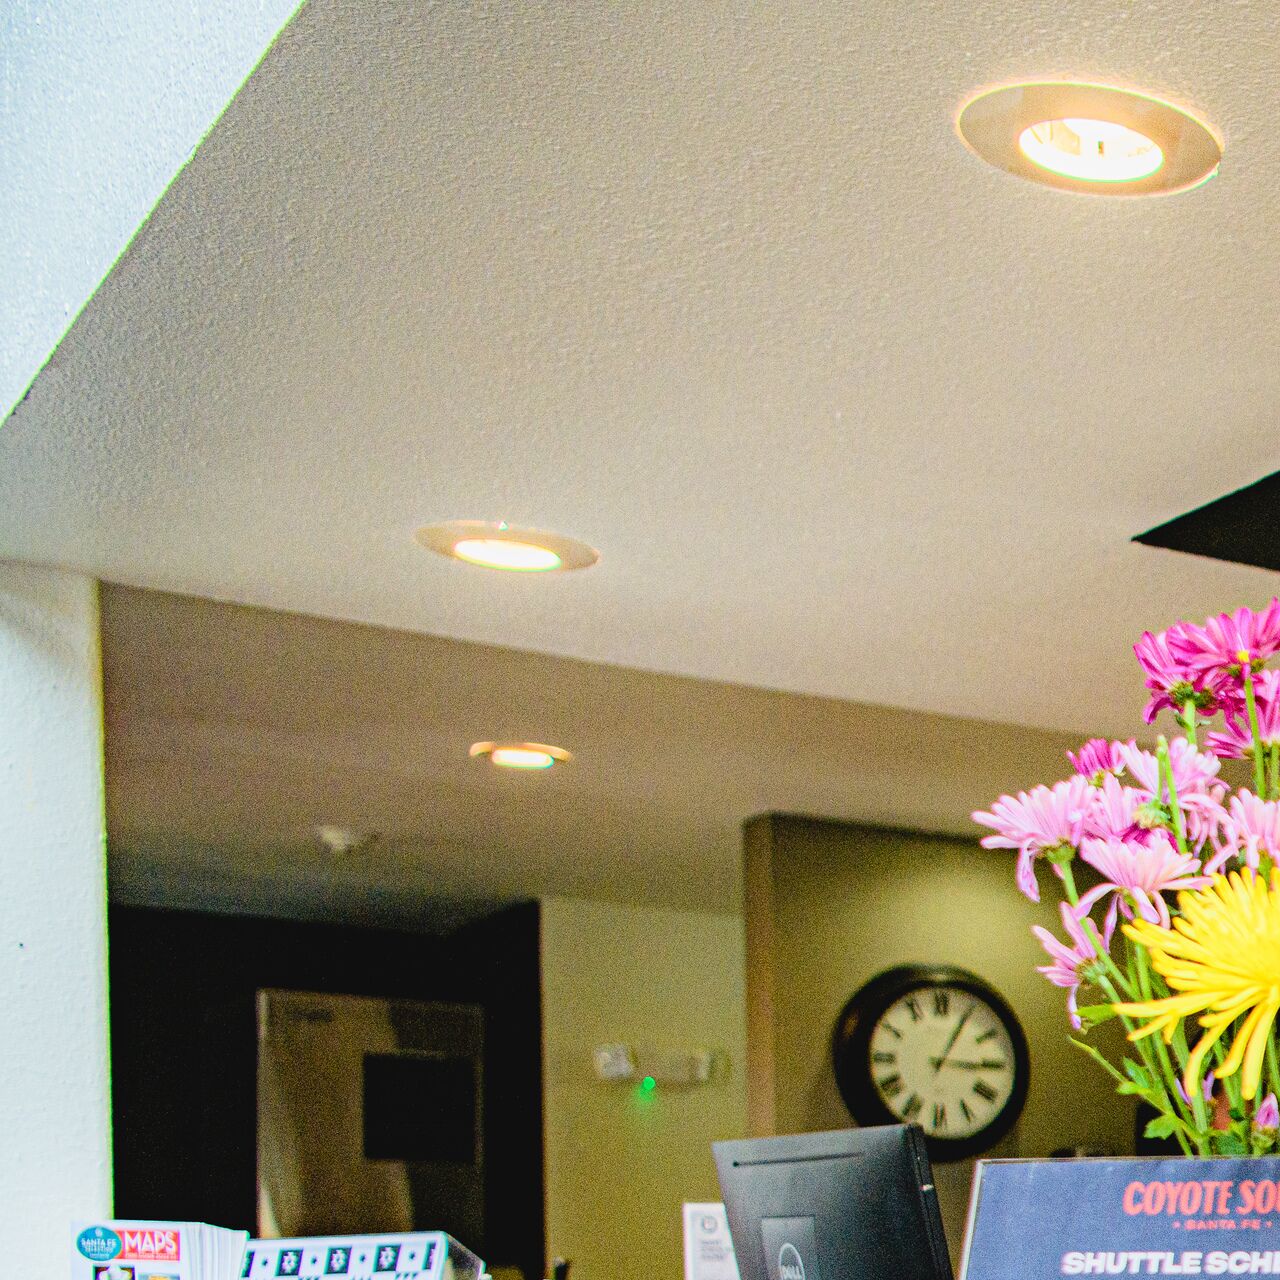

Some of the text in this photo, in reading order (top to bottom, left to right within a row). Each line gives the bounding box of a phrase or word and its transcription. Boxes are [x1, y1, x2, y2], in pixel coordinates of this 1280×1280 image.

[1122, 1180, 1234, 1216] COYOTE
[1184, 1219, 1261, 1230] SANTA FE
[125, 1231, 176, 1254] MAPS
[1060, 1250, 1203, 1275] SHUTTLE
